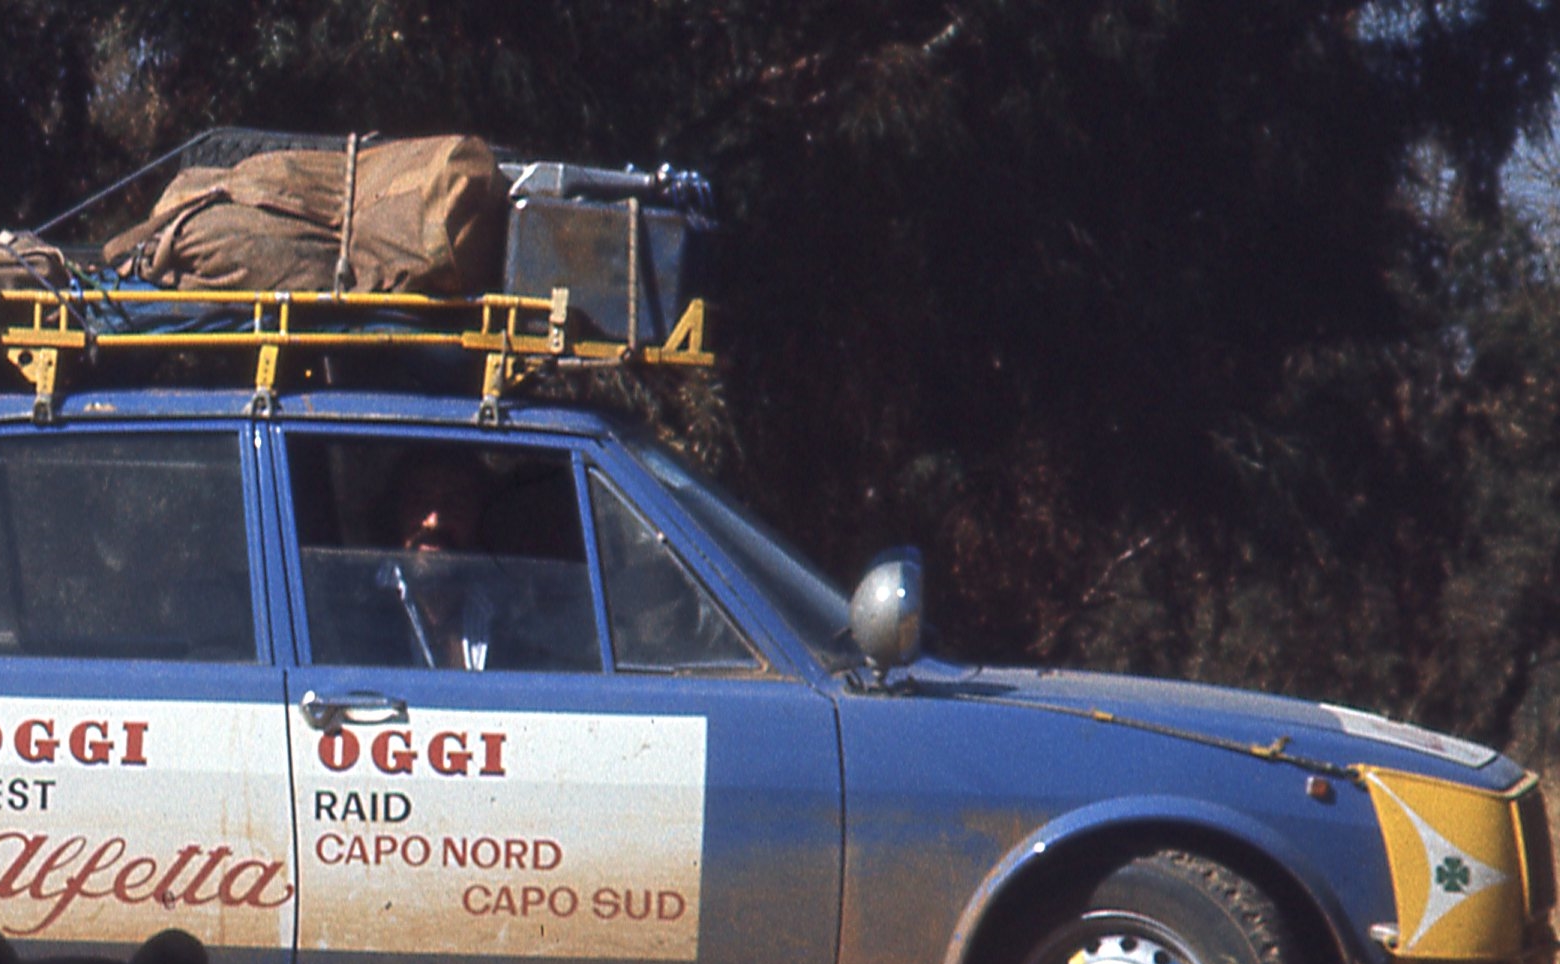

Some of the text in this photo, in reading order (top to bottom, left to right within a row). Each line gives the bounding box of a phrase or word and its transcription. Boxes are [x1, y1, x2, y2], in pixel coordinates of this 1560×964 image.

[317, 726, 508, 777] OGGI
[314, 790, 413, 823] RAID
[315, 833, 563, 871] CAPO NORD
[461, 884, 687, 922] CAPO SUD
